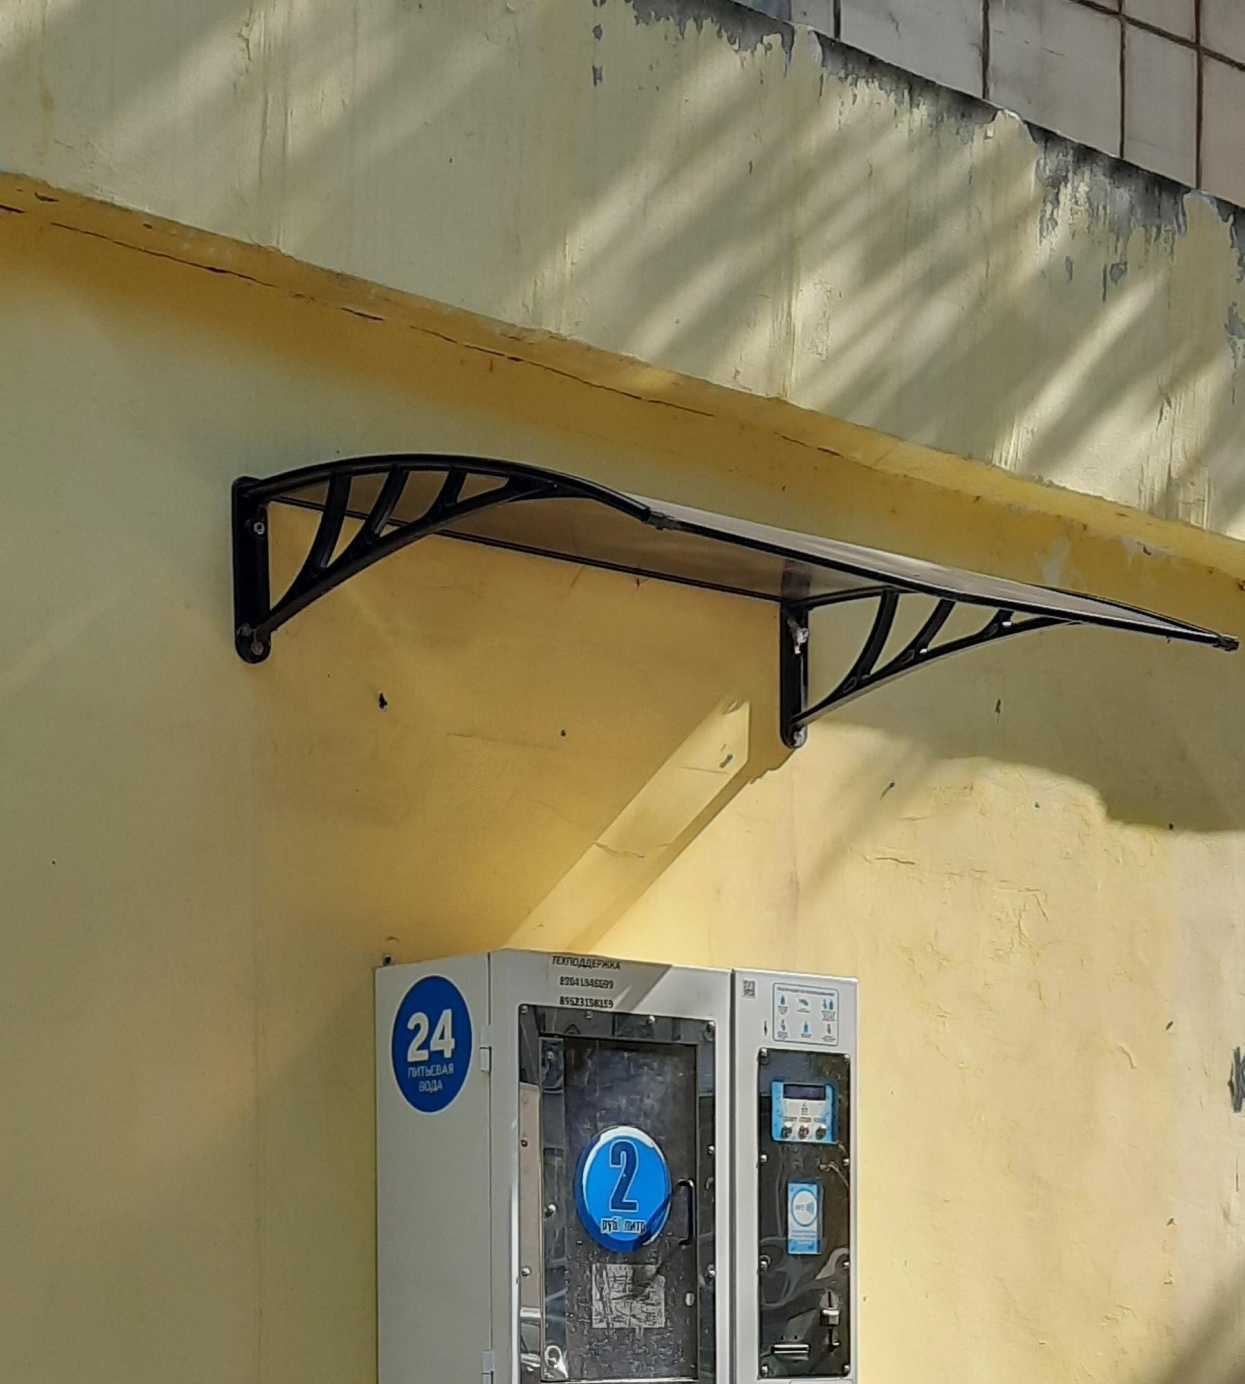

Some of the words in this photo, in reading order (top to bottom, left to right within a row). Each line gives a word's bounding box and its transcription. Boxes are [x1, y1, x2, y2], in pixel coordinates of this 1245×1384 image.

[552, 956, 622, 970] ТЕХПОДДЕРЖКА
[407, 1008, 455, 1062] 24
[407, 1063, 454, 1079] ПИТЬЕВАЯ
[418, 1080, 443, 1093] ВОДА
[609, 1139, 639, 1212] 2
